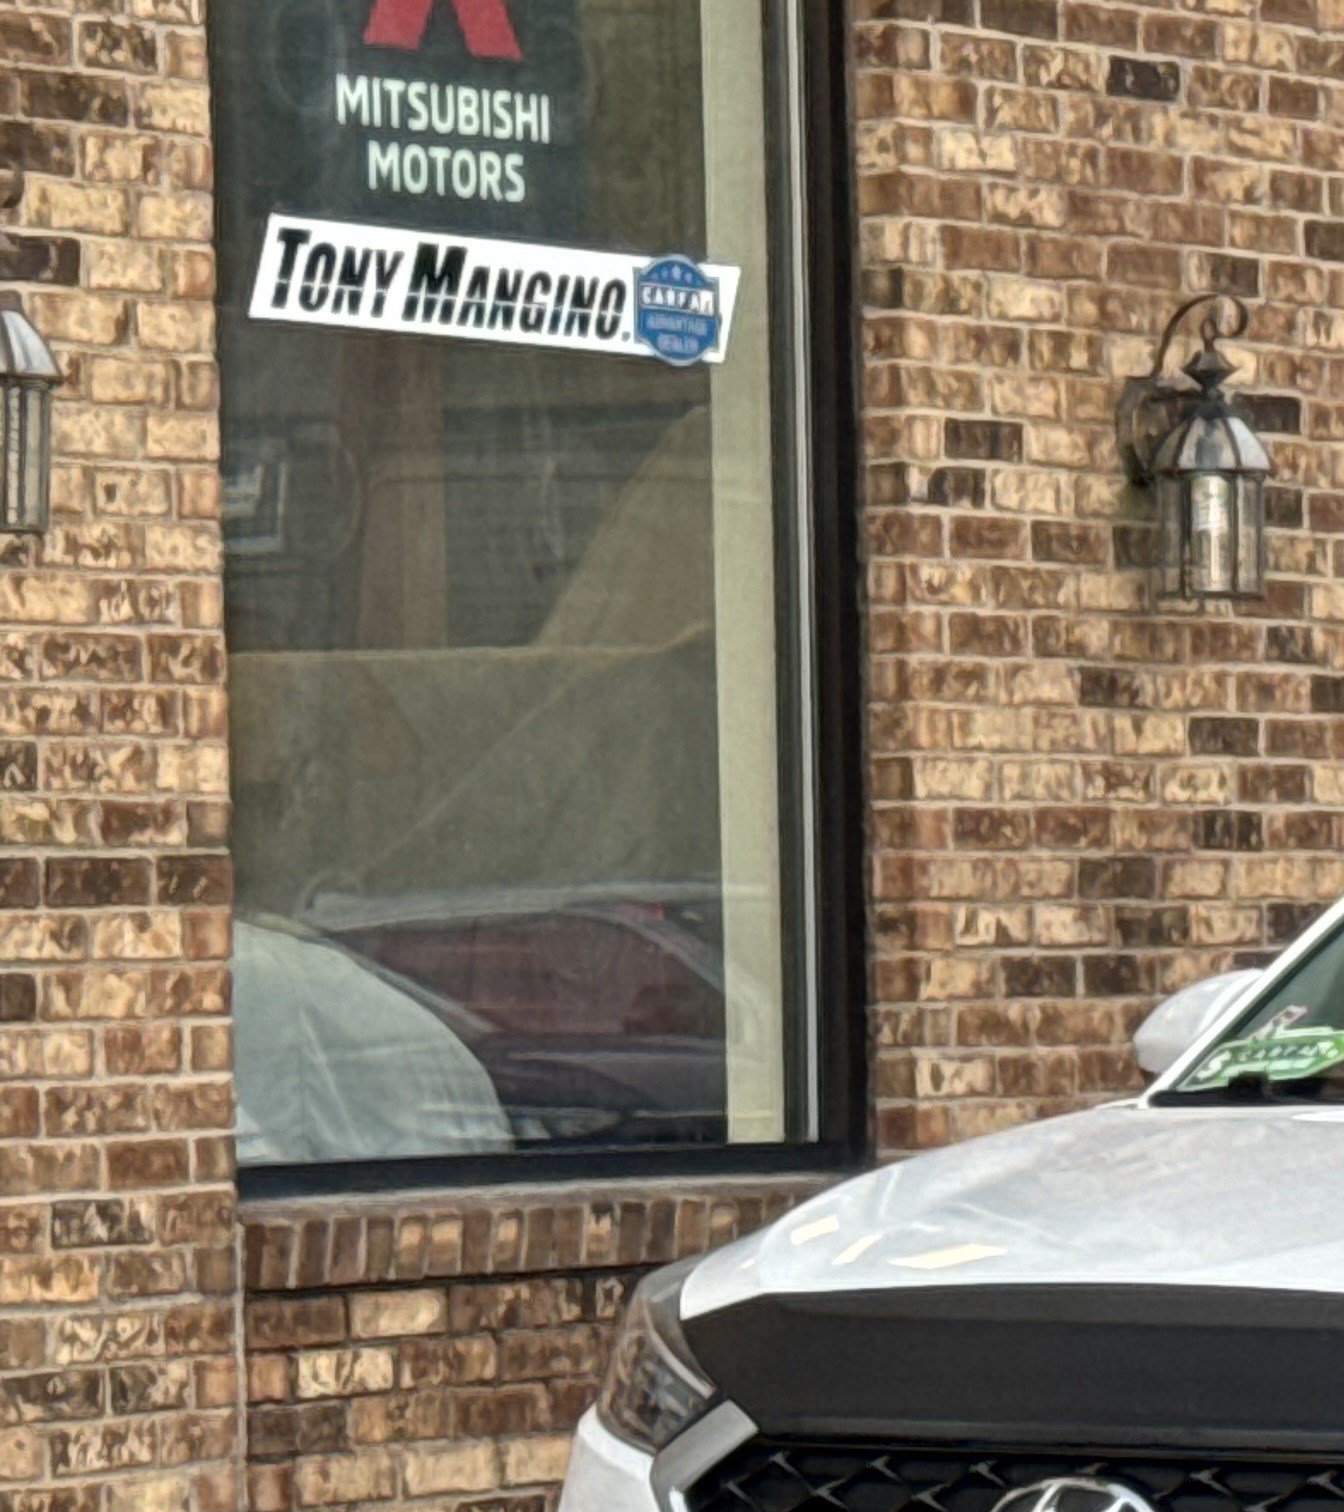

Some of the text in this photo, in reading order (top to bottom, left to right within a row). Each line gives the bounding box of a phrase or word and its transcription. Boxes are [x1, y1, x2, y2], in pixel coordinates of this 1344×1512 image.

[334, 72, 550, 144] MITSUBISHI
[367, 139, 526, 203] MOTORS
[270, 227, 405, 319] TONY
